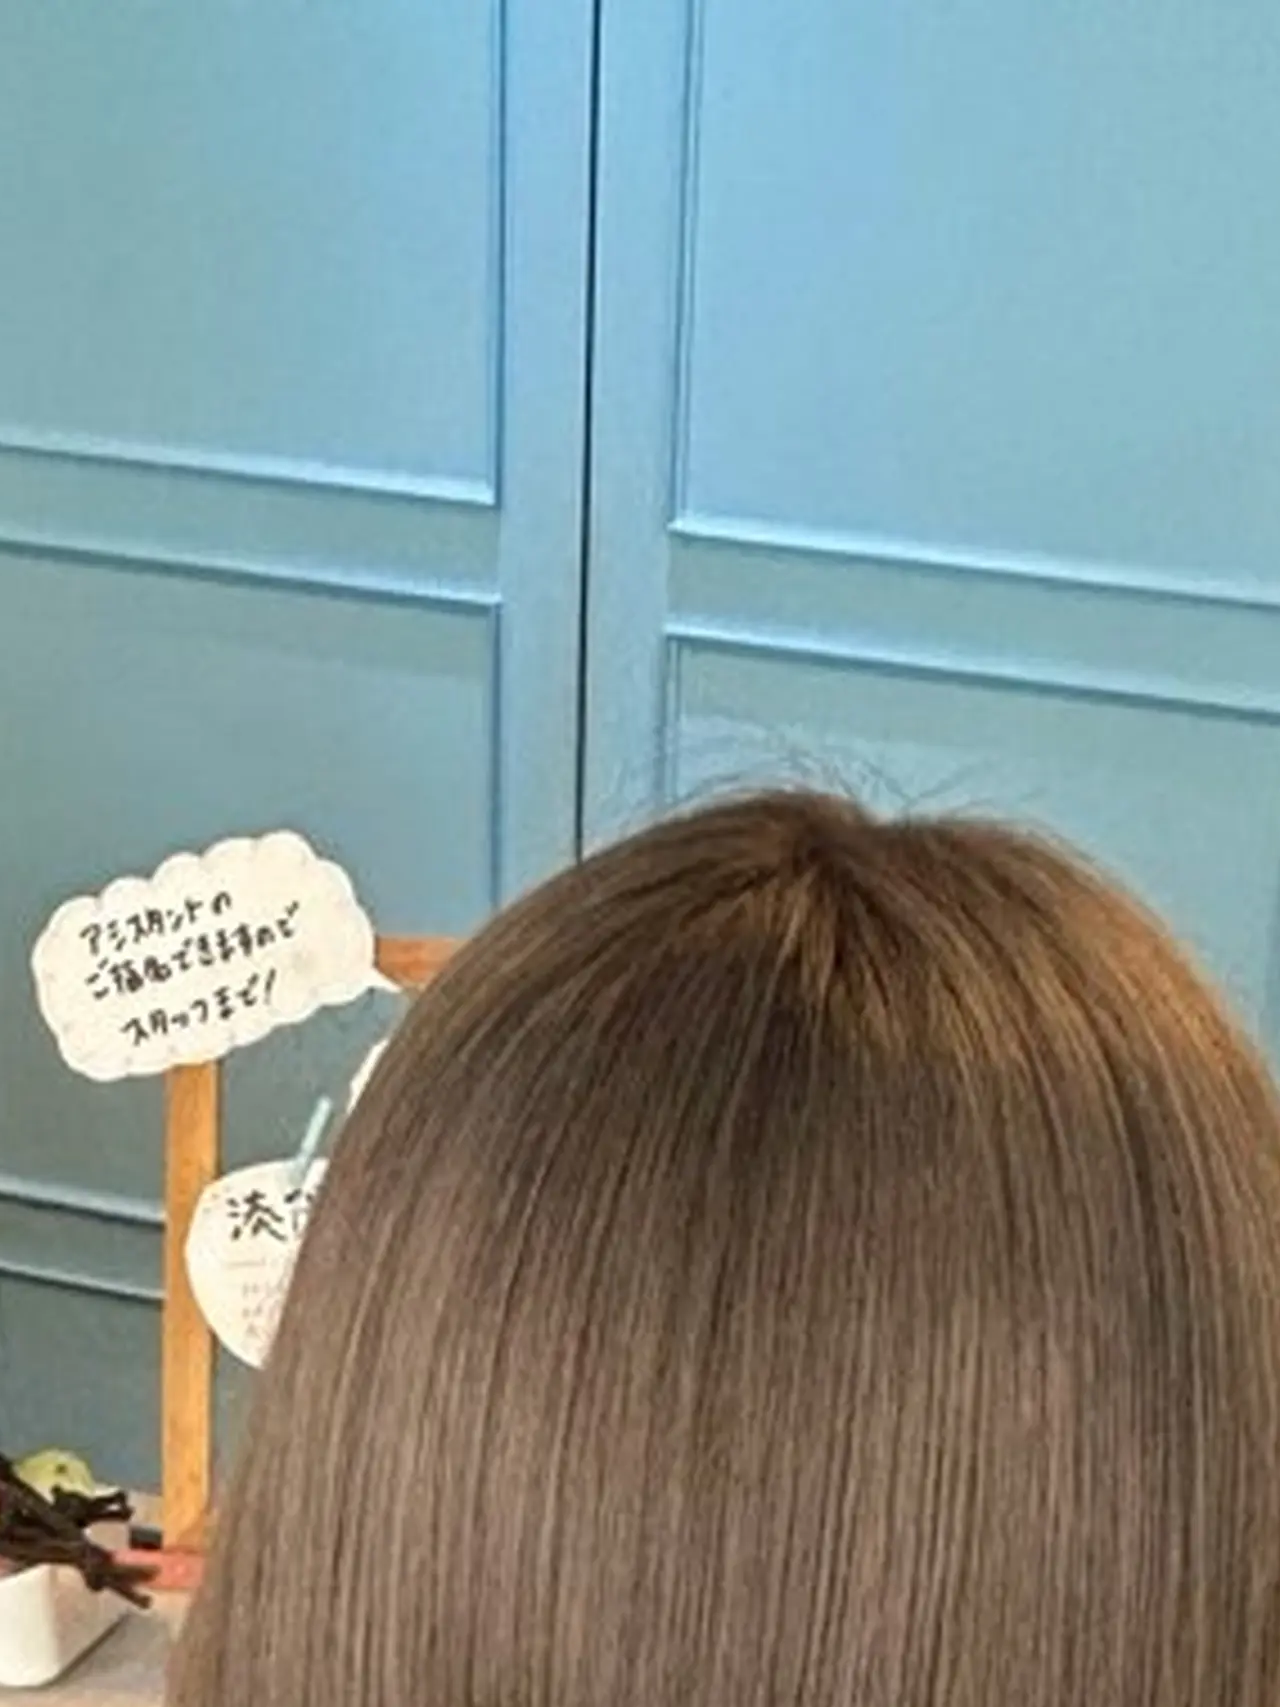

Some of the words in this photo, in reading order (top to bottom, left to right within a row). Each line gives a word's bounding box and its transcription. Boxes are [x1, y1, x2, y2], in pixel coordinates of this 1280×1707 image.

[79, 891, 232, 955] アシスタントの
